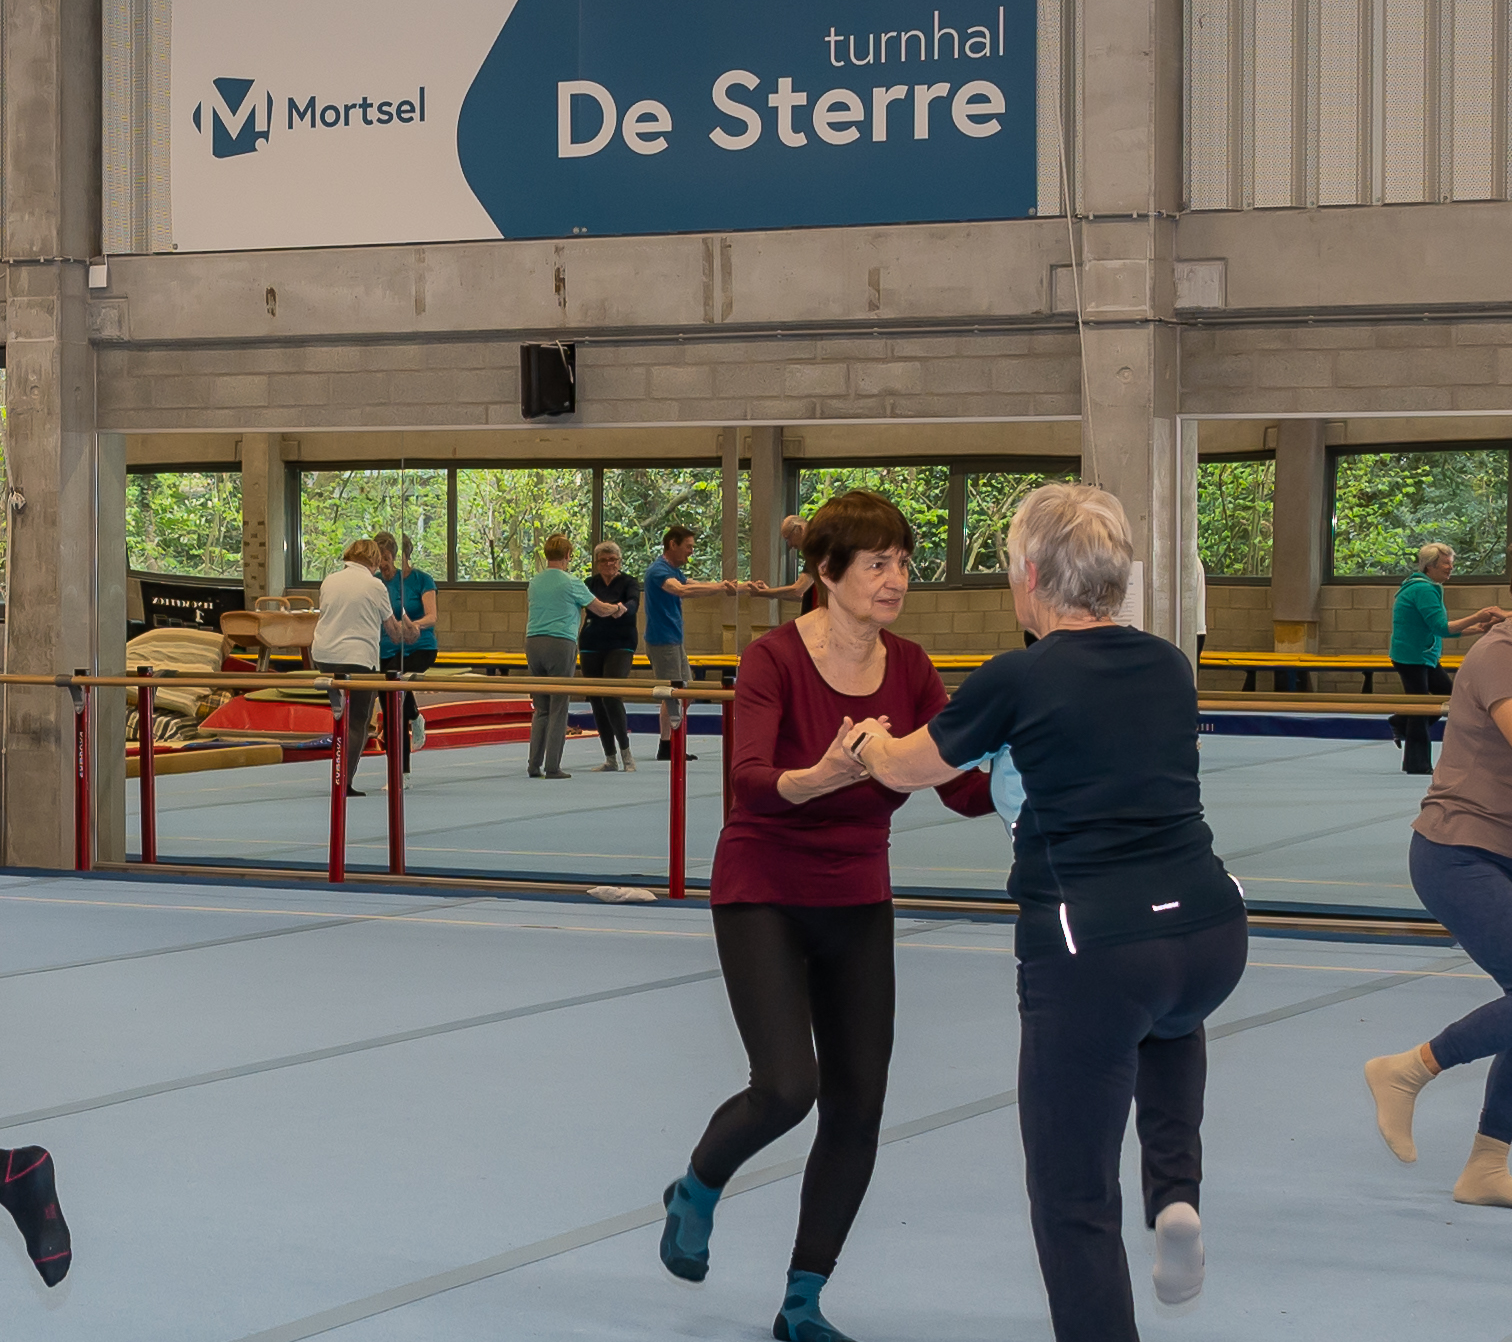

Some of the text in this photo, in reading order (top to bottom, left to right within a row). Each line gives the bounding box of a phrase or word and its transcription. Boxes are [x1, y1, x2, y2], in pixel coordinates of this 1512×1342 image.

[825, 6, 1005, 67] turnhal
[287, 86, 426, 130] Mortsel
[557, 69, 1006, 158] De Sterre
